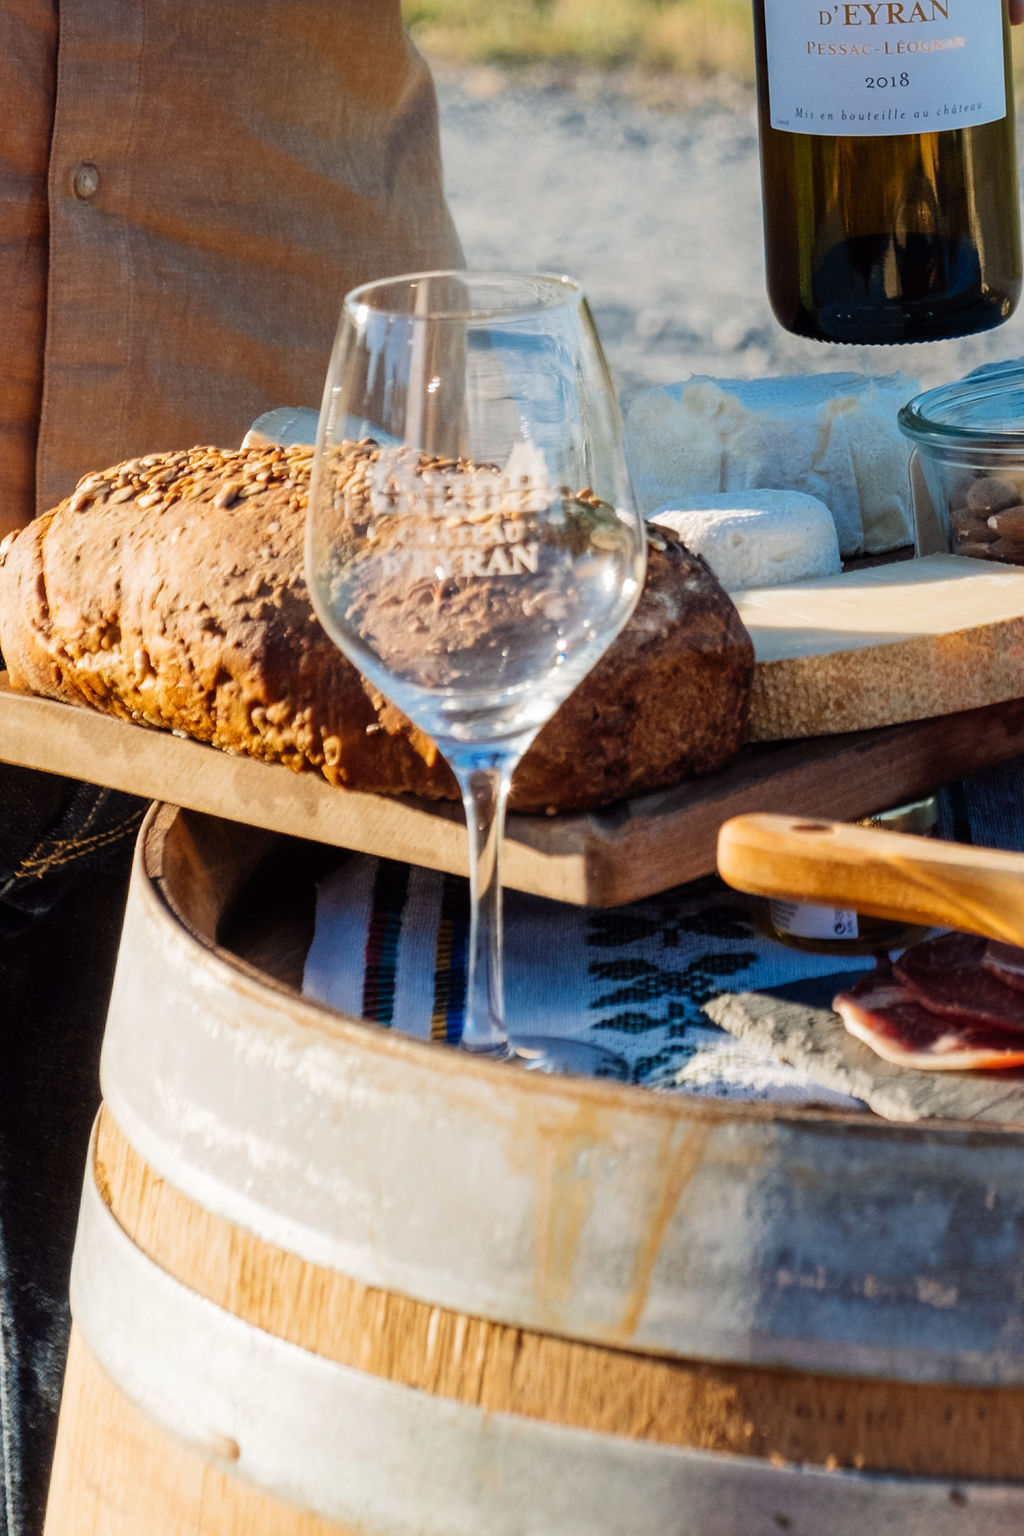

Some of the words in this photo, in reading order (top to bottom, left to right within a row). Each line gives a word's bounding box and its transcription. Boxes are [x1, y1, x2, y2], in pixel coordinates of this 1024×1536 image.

[865, 71, 910, 89] 2018
[794, 107, 814, 120] Mis
[820, 112, 834, 121] en
[841, 108, 906, 122] bouteille
[913, 109, 929, 119] au
[936, 102, 982, 117] château
